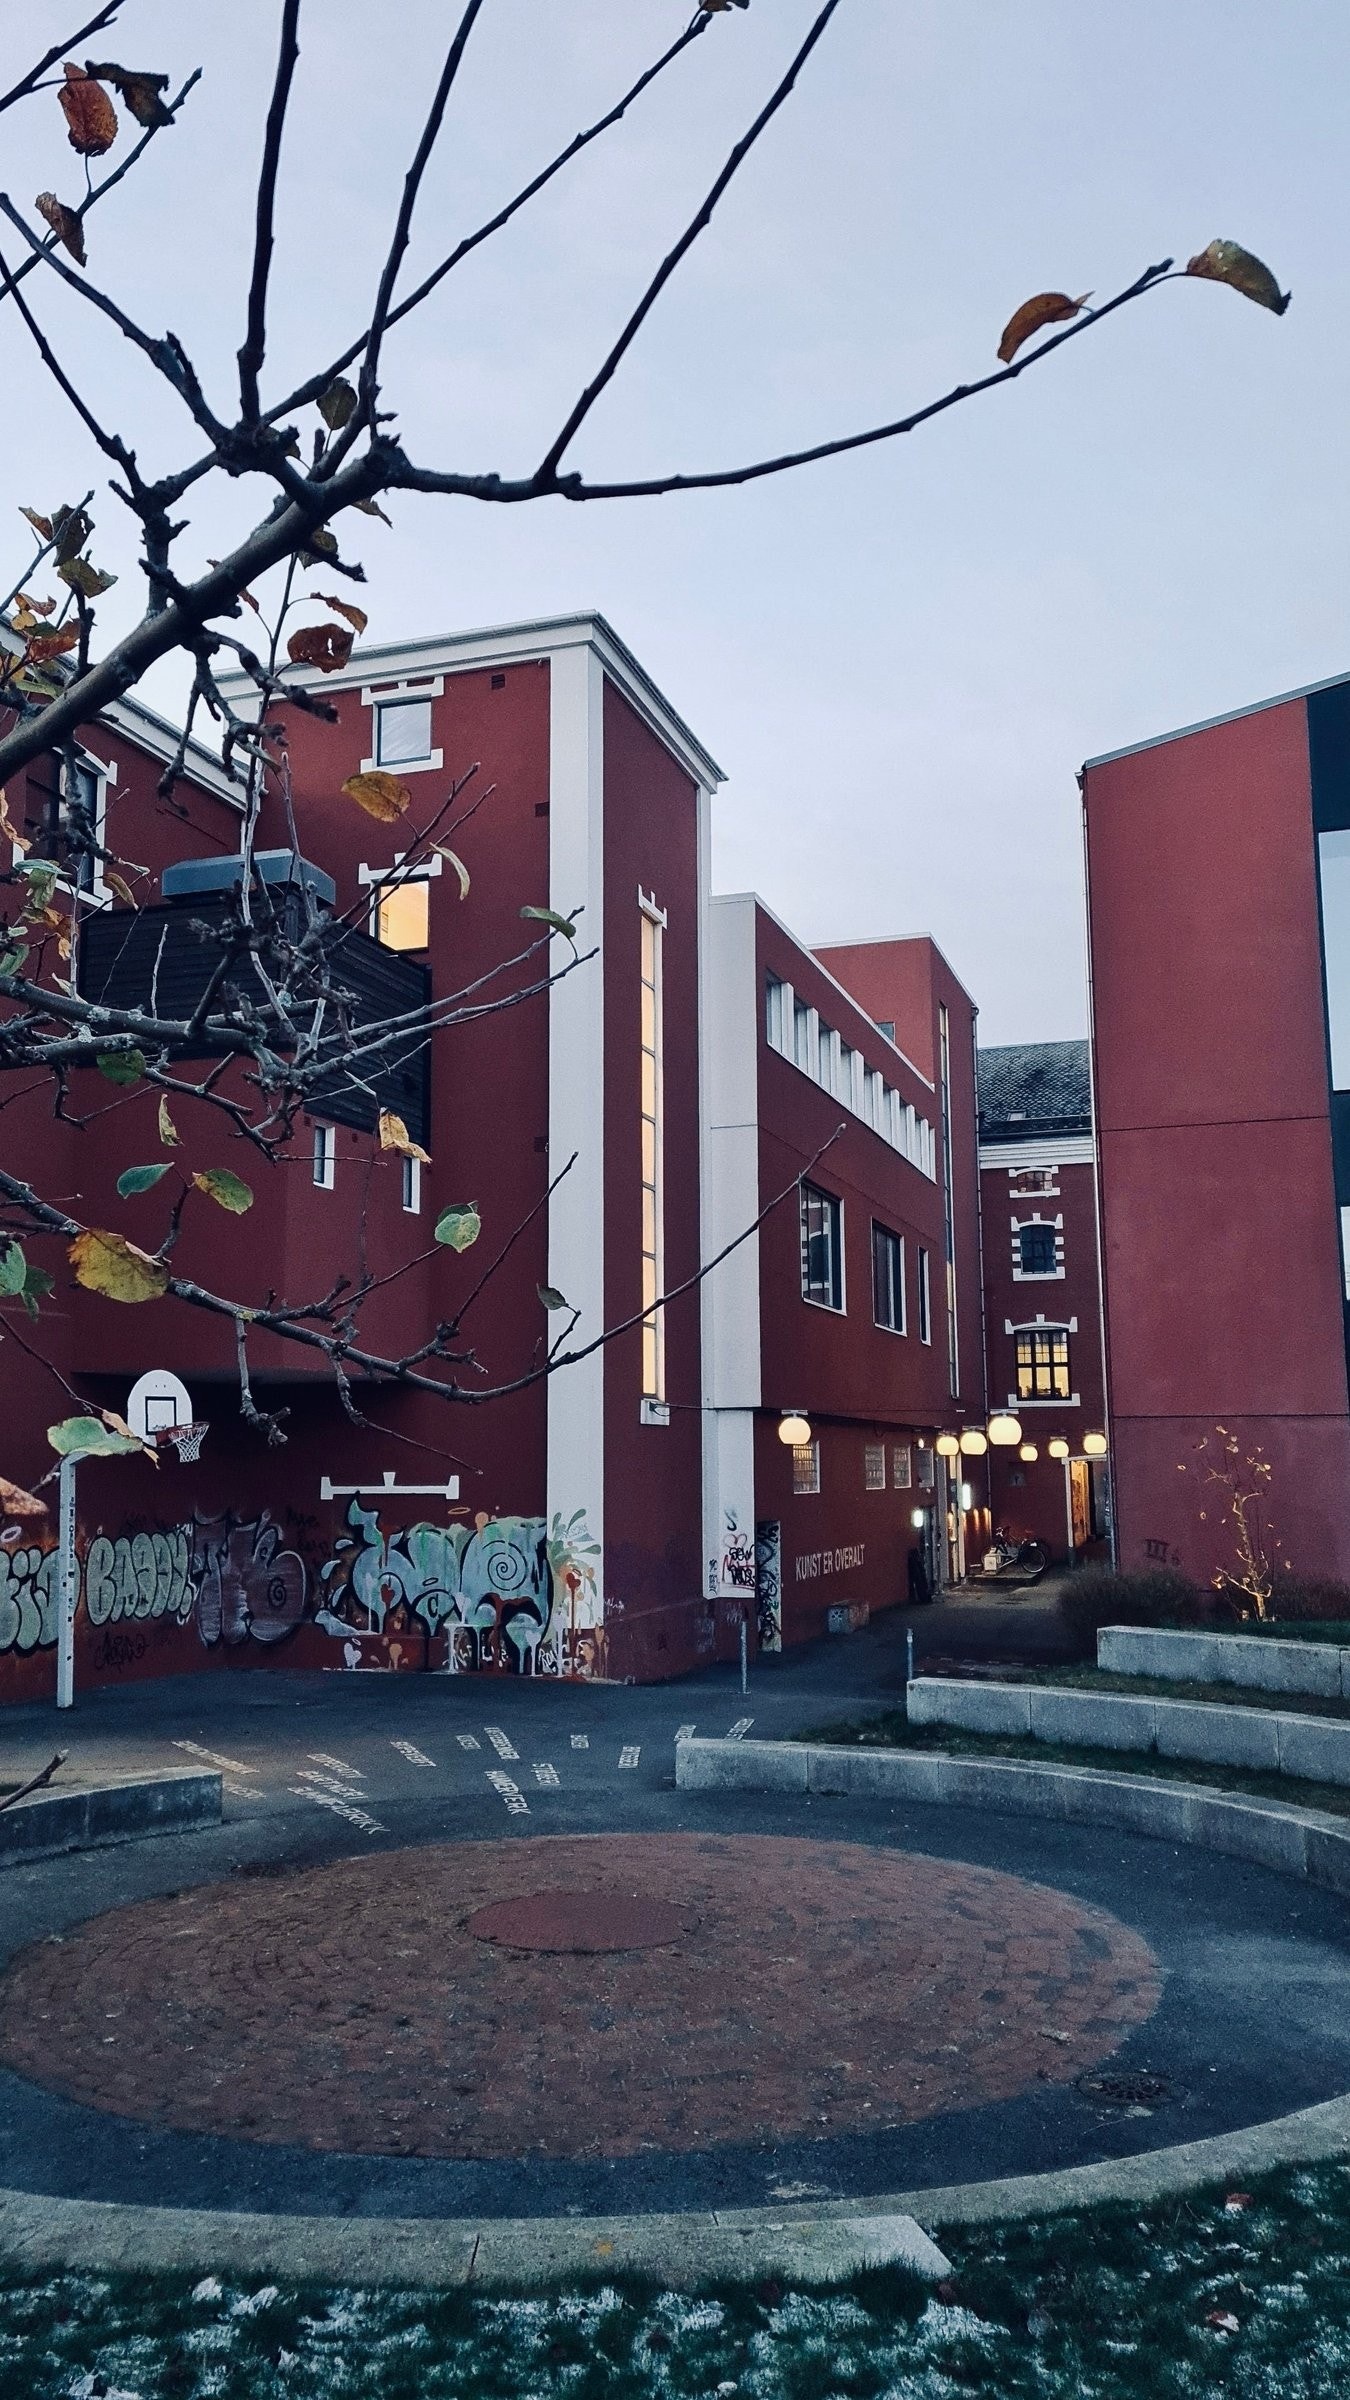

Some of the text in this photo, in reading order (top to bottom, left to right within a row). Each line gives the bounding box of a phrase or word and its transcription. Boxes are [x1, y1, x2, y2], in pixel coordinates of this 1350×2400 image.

[796, 1544, 865, 1581] KUNST ER OVERALT
